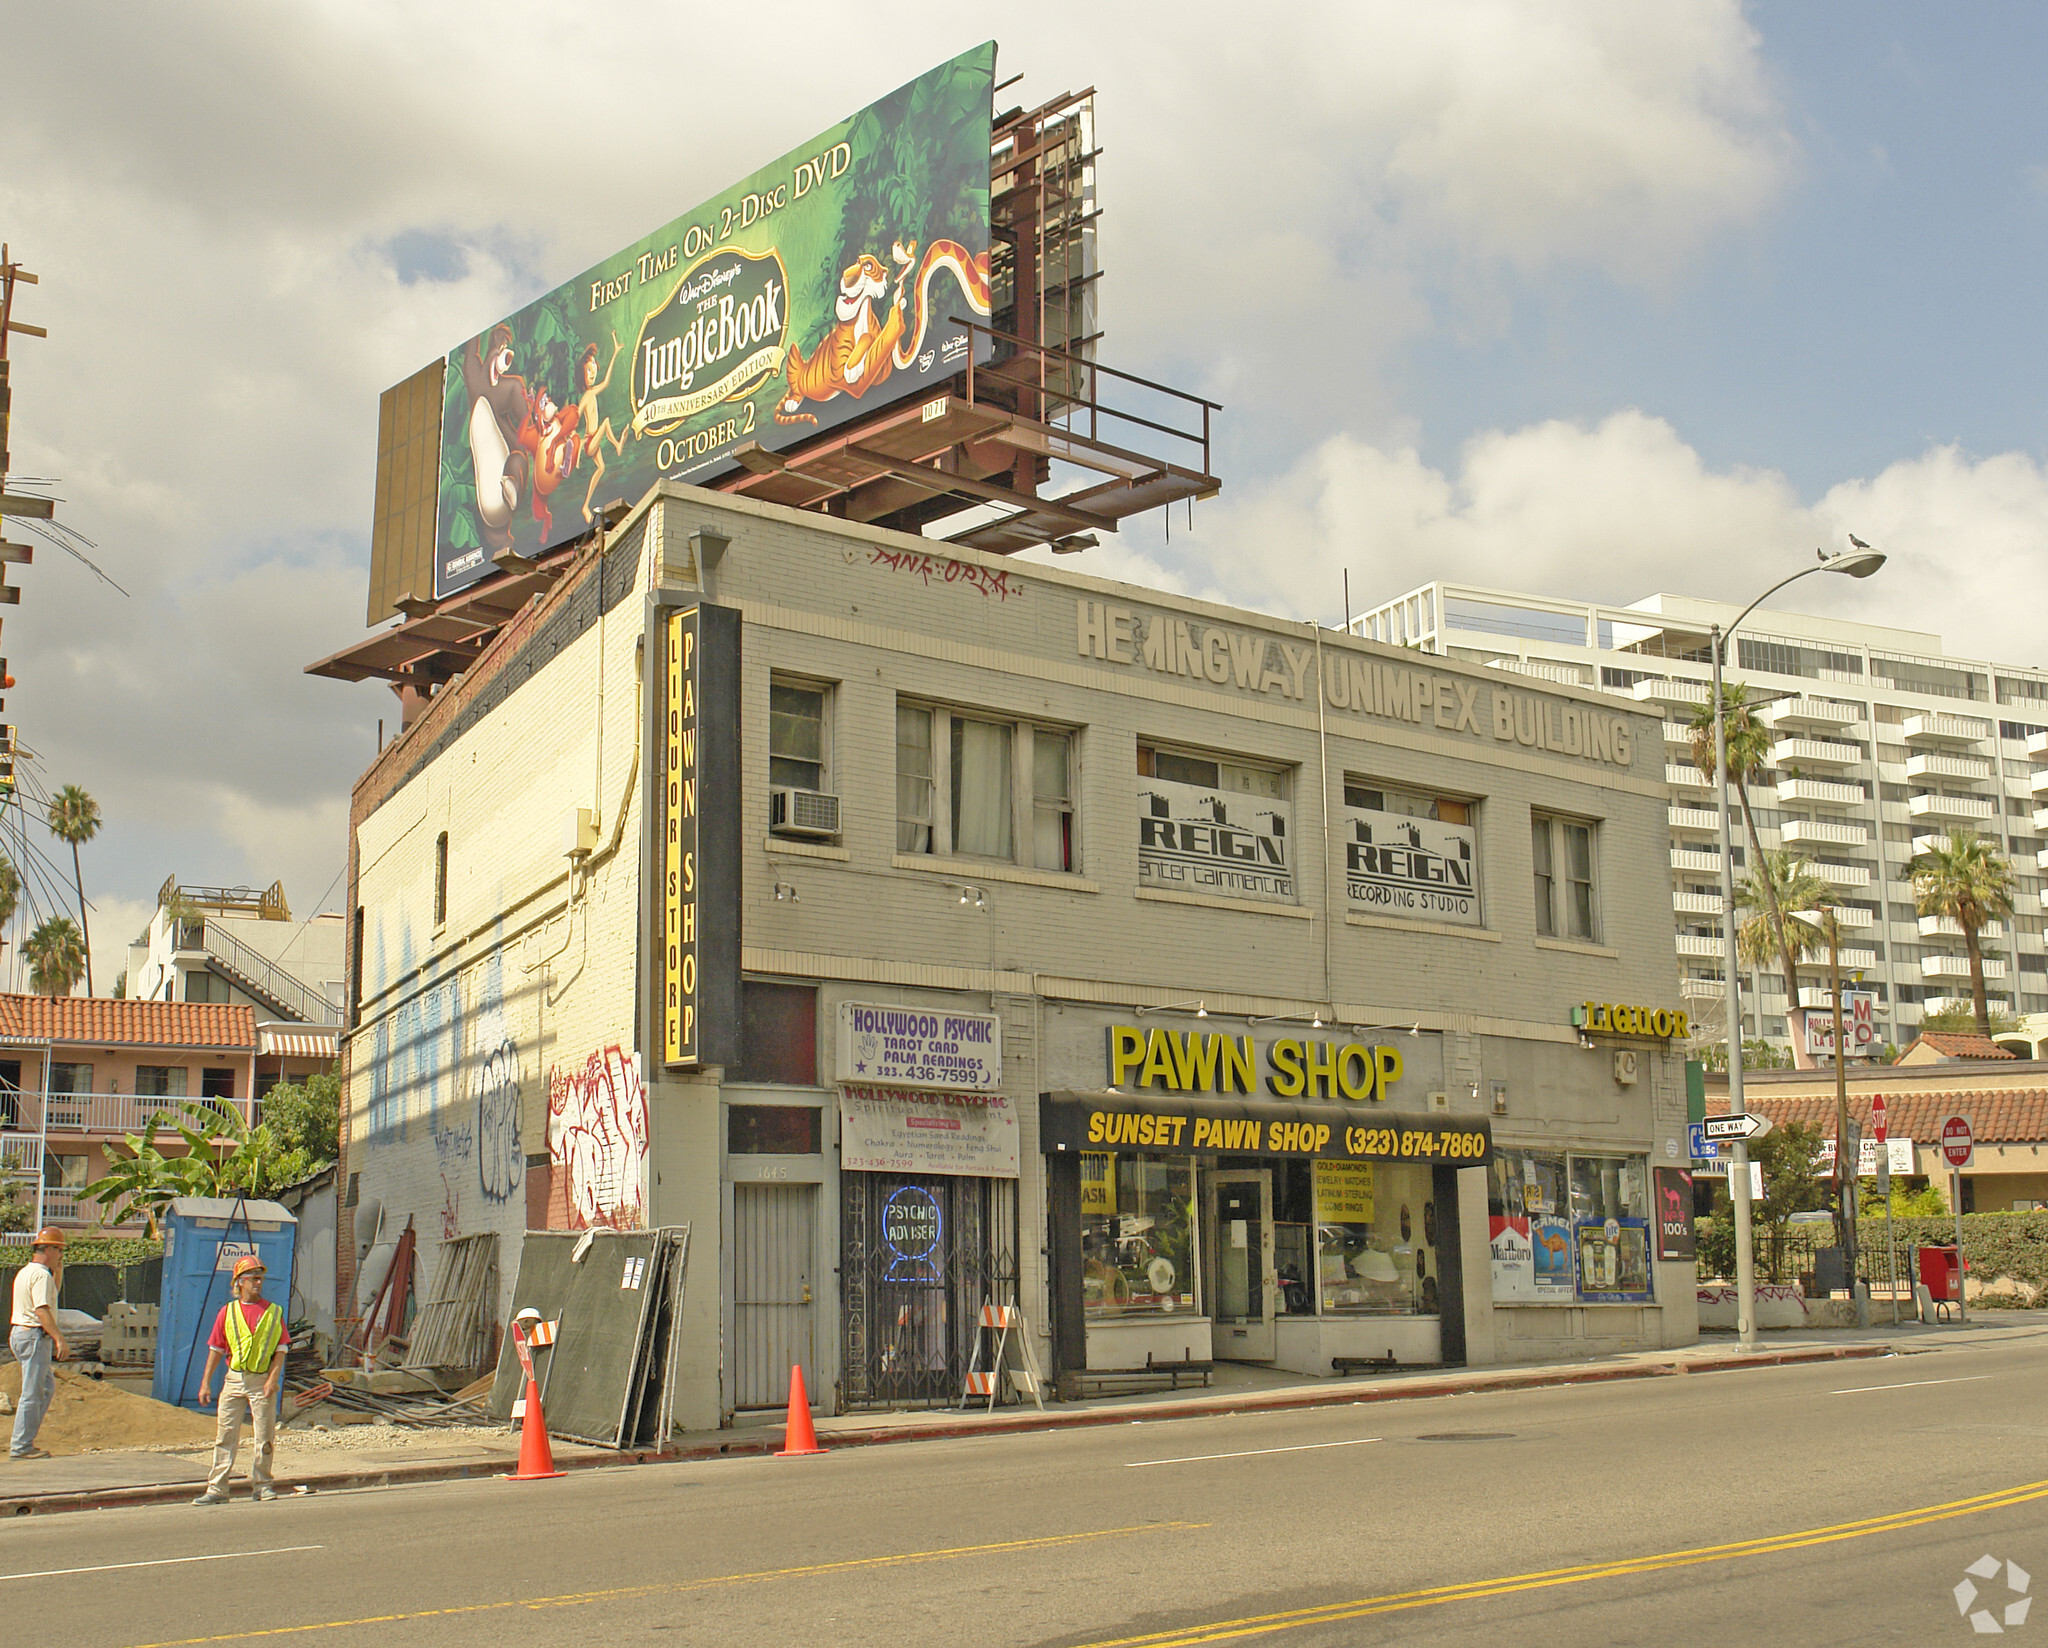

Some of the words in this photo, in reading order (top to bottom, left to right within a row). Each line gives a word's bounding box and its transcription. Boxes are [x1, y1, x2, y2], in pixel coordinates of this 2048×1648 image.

[590, 271, 632, 312] FIRST
[637, 245, 677, 285] TIME
[684, 224, 714, 258] ON
[719, 184, 786, 241] 2-DISC
[793, 141, 851, 200] DVD
[697, 294, 718, 314] THE
[667, 383, 729, 415] ANNIVERSARY
[731, 352, 774, 388] EDITION
[924, 401, 944, 419] 1071
[656, 418, 739, 471] OCTOBER
[742, 401, 756, 435] 2
[1325, 654, 1481, 735] UNIMPEX
[1491, 690, 1632, 766] BUILDING
[682, 631, 696, 819] PAWN
[670, 638, 678, 843] LIQUOR
[1140, 817, 1285, 866] REIGN
[1346, 842, 1471, 886] REIGN
[1347, 883, 1415, 908] RECORDING
[1420, 893, 1469, 915] STUDIO
[669, 870, 677, 1046] STORE
[682, 851, 696, 1045] SHOP
[854, 1009, 939, 1039] HOLLYWOOD
[944, 1017, 992, 1043] PSYCHIC
[1584, 1001, 1691, 1038] LIQUOR
[884, 1037, 923, 1051] TAROT
[928, 1041, 959, 1054] CARD
[1814, 1034, 1825, 1047] LA
[884, 1051, 917, 1065] PALM
[923, 1054, 984, 1070] READINGS
[1106, 1025, 1256, 1094] PAWN
[1266, 1038, 1403, 1100] SHOP
[844, 1086, 940, 1105] HOLLYWOOD
[943, 1093, 1009, 1109] PSYCHIC
[1709, 1123, 1725, 1133] ONE
[1727, 1121, 1744, 1132] WAY
[1872, 1109, 1886, 1129] STOP
[1088, 1111, 1187, 1145] SUNSET
[1193, 1118, 1262, 1150] PAWN
[1268, 1121, 1331, 1152] SHOP
[1945, 1127, 1954, 1135] DO
[1956, 1126, 1967, 1135] NOT
[864, 1138, 895, 1147] Chakra
[907, 1140, 954, 1151] Numerology
[966, 1143, 984, 1152] Feng
[1948, 1148, 1967, 1157] ENTER
[847, 1158, 913, 1169] 323-436-7599
[894, 1150, 913, 1158] Aura
[926, 1151, 945, 1160] Tarot
[957, 1153, 976, 1161] Palm
[758, 1166, 787, 1180] 1645
[1080, 1152, 1109, 1182] HOP
[1317, 1162, 1334, 1171] GOLD
[1336, 1162, 1368, 1173] DIAMONDS
[1345, 1177, 1371, 1187] WATCHES
[1317, 1188, 1343, 1198] LATINUM
[1345, 1189, 1373, 1200] STERLING
[889, 1204, 936, 1220] PSYCHIC
[1346, 1203, 1364, 1212] RINGS
[1532, 1216, 1570, 1232] CAMEL
[1663, 1222, 1688, 1236] 100's
[1490, 1240, 1531, 1261] Marlboro
